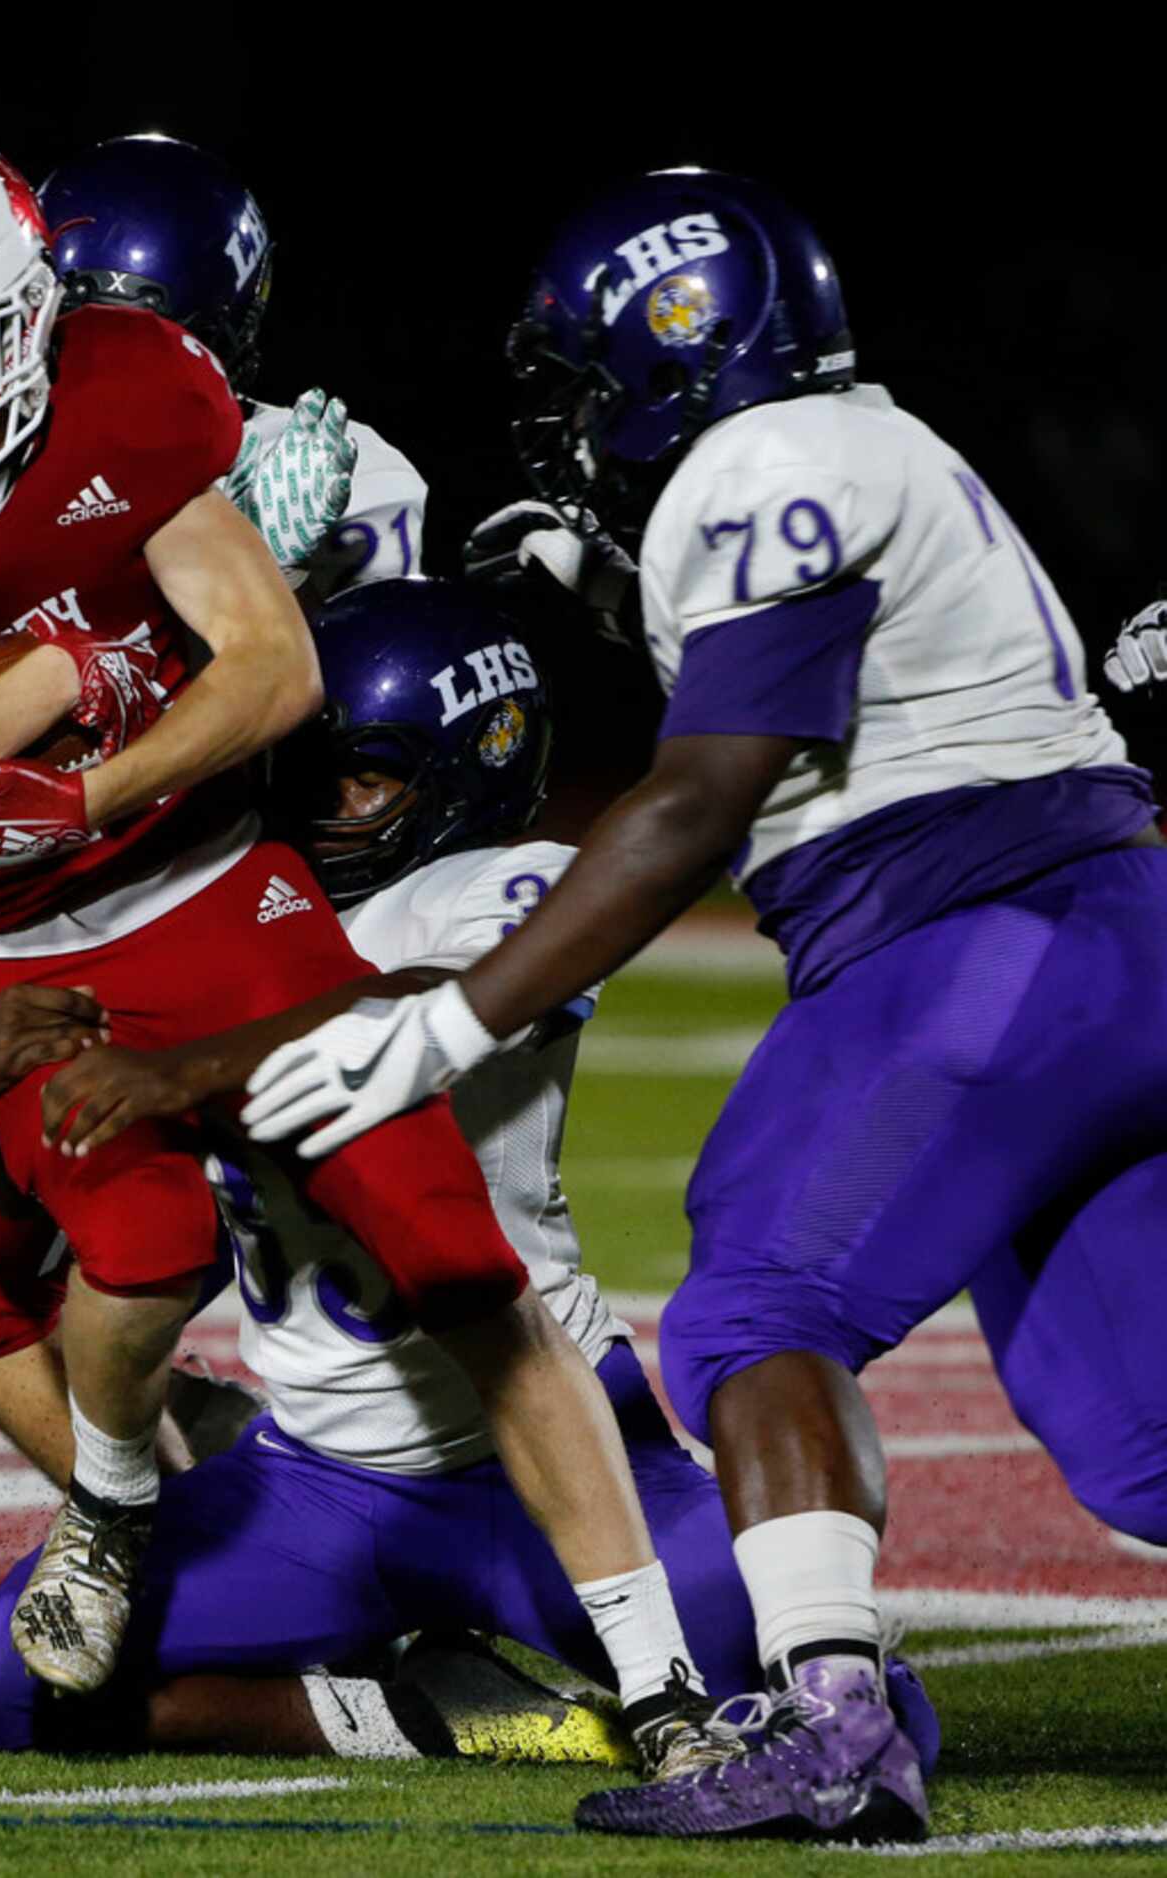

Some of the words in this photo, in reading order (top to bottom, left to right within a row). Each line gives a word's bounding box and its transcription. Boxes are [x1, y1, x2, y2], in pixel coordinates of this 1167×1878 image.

[583, 212, 730, 326] LHS
[56, 499, 131, 527] adidas
[699, 497, 843, 603] 79
[429, 641, 539, 728] LHS
[256, 897, 313, 925] adidas
